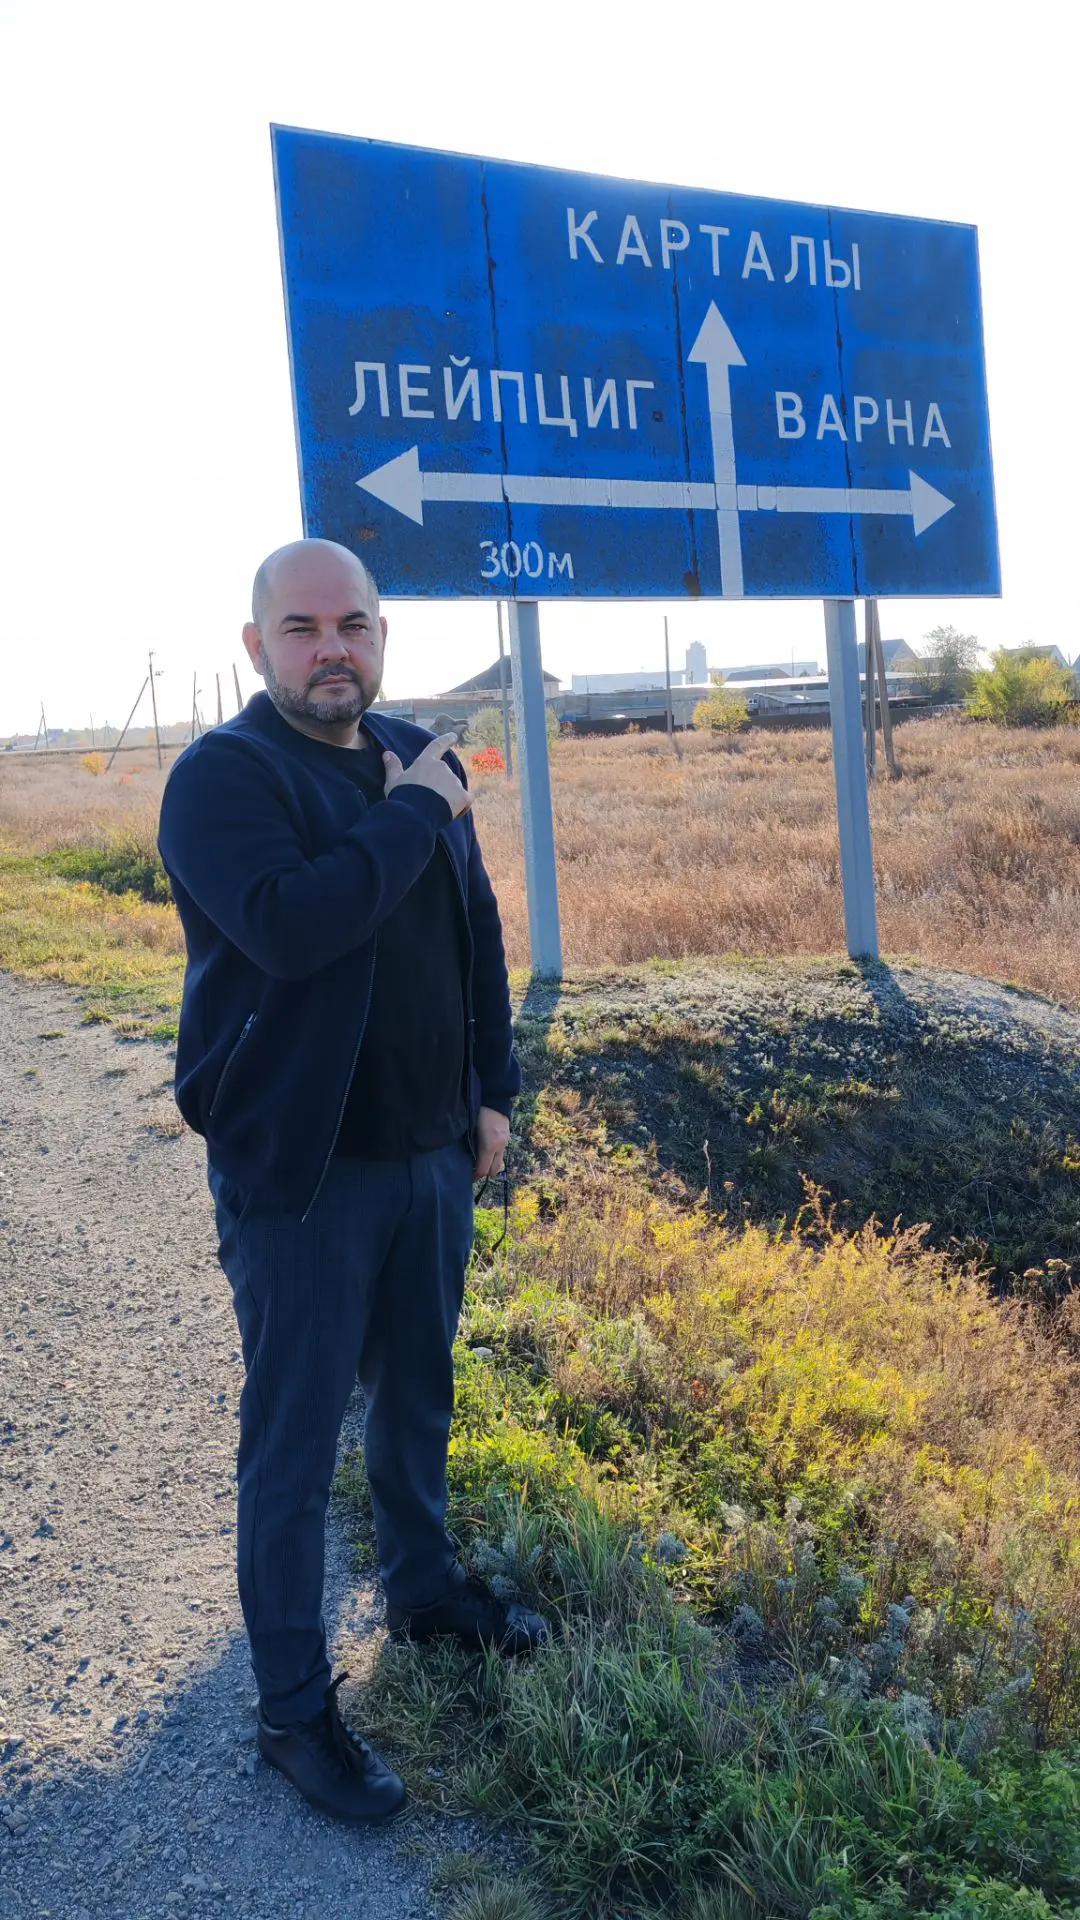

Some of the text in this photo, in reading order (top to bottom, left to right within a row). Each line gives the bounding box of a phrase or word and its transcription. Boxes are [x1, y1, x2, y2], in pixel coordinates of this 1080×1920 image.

[566, 207, 862, 291] КАРТАЛЫ
[348, 355, 655, 438] ЛЕЙПЦИГ
[775, 391, 953, 449] ВАРНА
[479, 540, 574, 580] 300м
